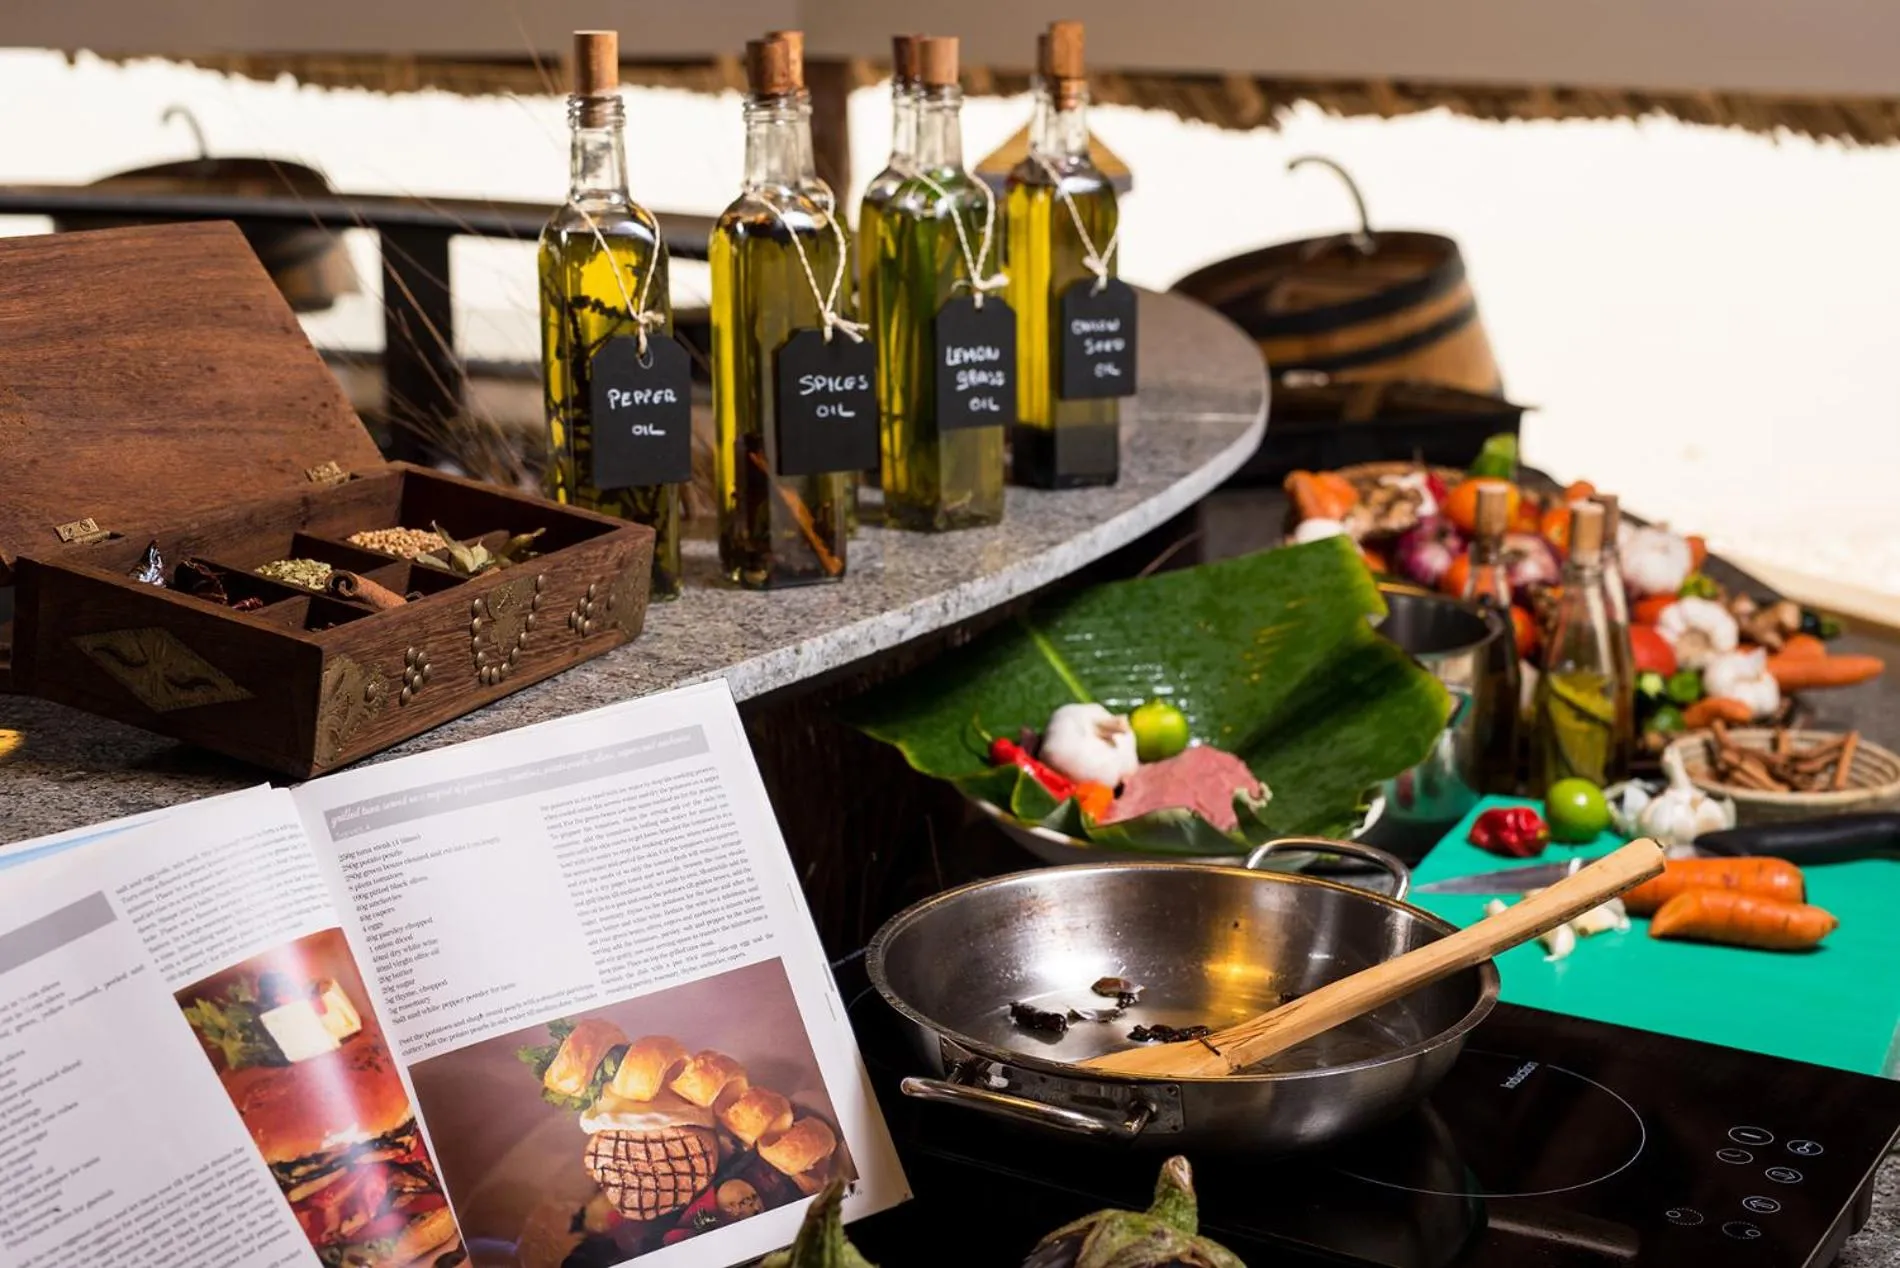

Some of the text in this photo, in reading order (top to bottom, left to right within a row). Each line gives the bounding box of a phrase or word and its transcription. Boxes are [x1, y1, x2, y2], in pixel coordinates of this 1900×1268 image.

[946, 345, 1001, 366] LEMON
[1094, 362, 1122, 378] OIL
[799, 374, 870, 395] SPICES
[608, 388, 677, 410] PEPPER
[968, 396, 1000, 412] OIL
[816, 402, 856, 418] OIL
[632, 423, 666, 436] OIL
